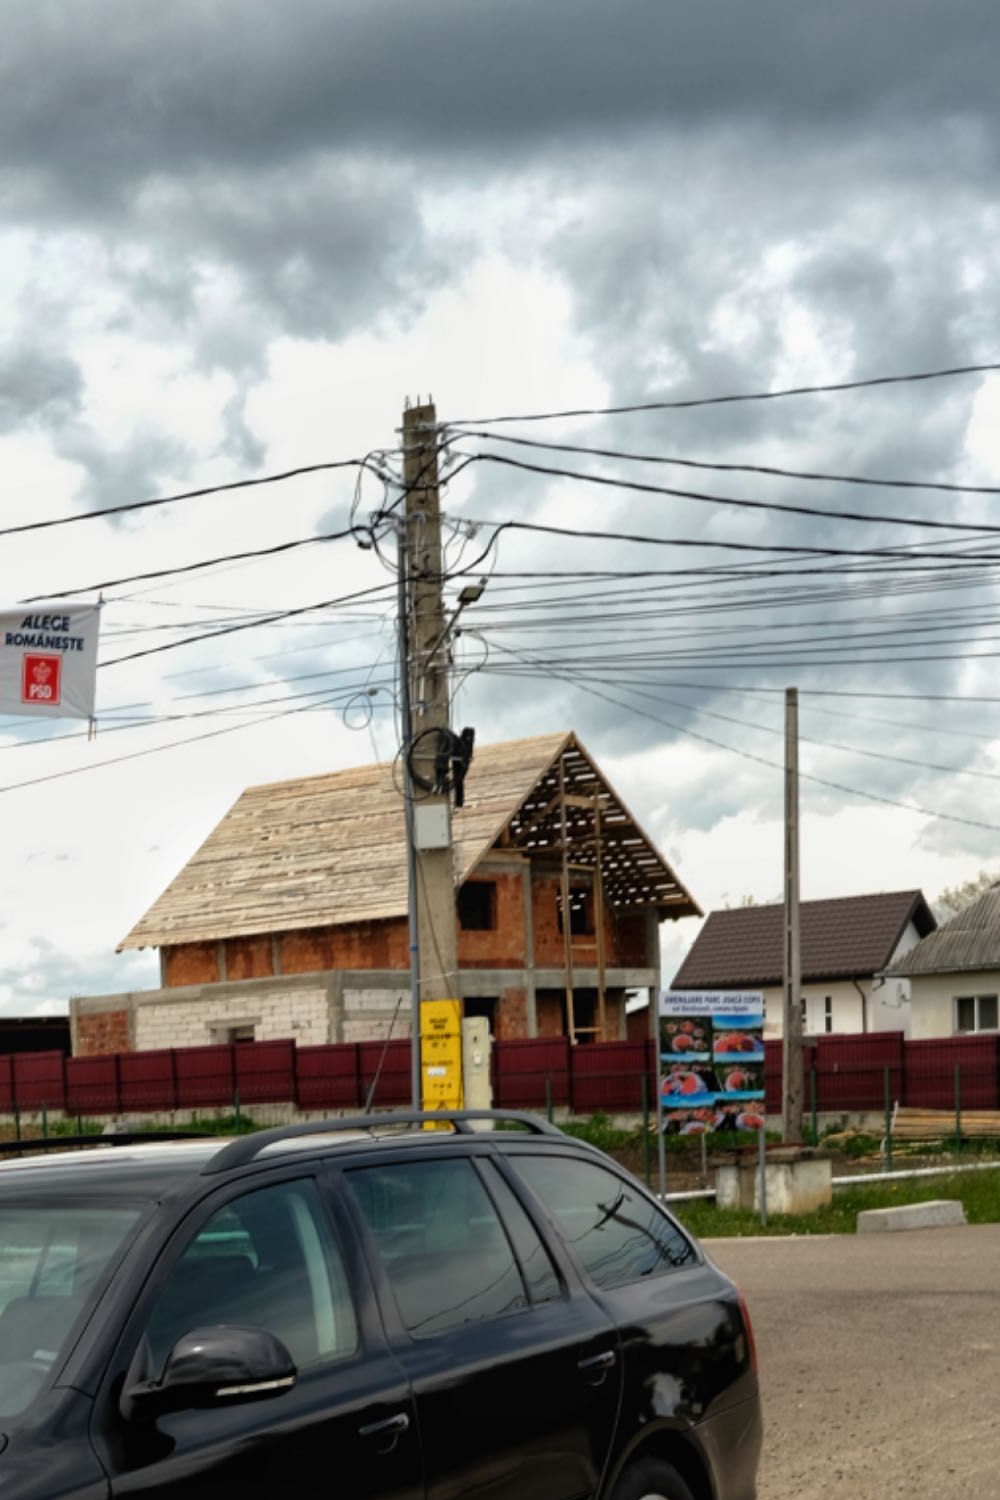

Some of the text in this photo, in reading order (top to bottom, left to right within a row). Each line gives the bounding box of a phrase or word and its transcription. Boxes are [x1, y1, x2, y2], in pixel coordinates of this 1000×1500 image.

[21, 615, 70, 631] ALEGE
[5, 632, 84, 654] ROMÂNEȘTE
[29, 683, 52, 699] PSD
